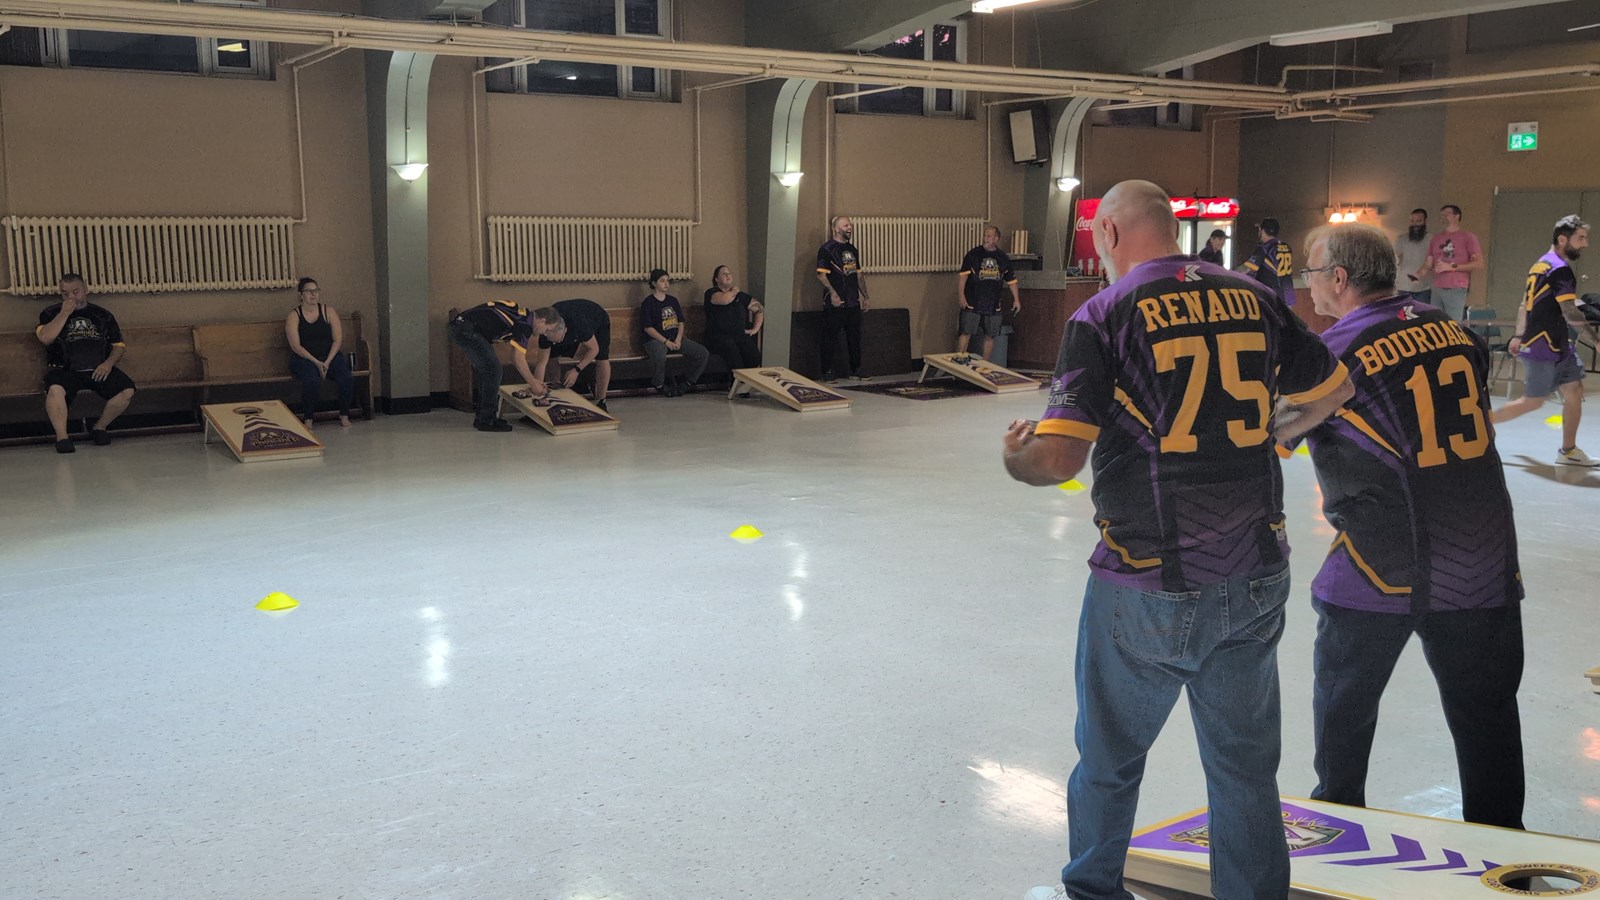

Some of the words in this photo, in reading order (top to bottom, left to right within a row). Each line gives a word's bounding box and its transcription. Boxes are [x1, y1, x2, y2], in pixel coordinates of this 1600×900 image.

[1137, 288, 1261, 332] RENAUD
[1355, 320, 1474, 377] BOURDAG
[1152, 332, 1269, 453] 75
[1405, 354, 1489, 468] 13
